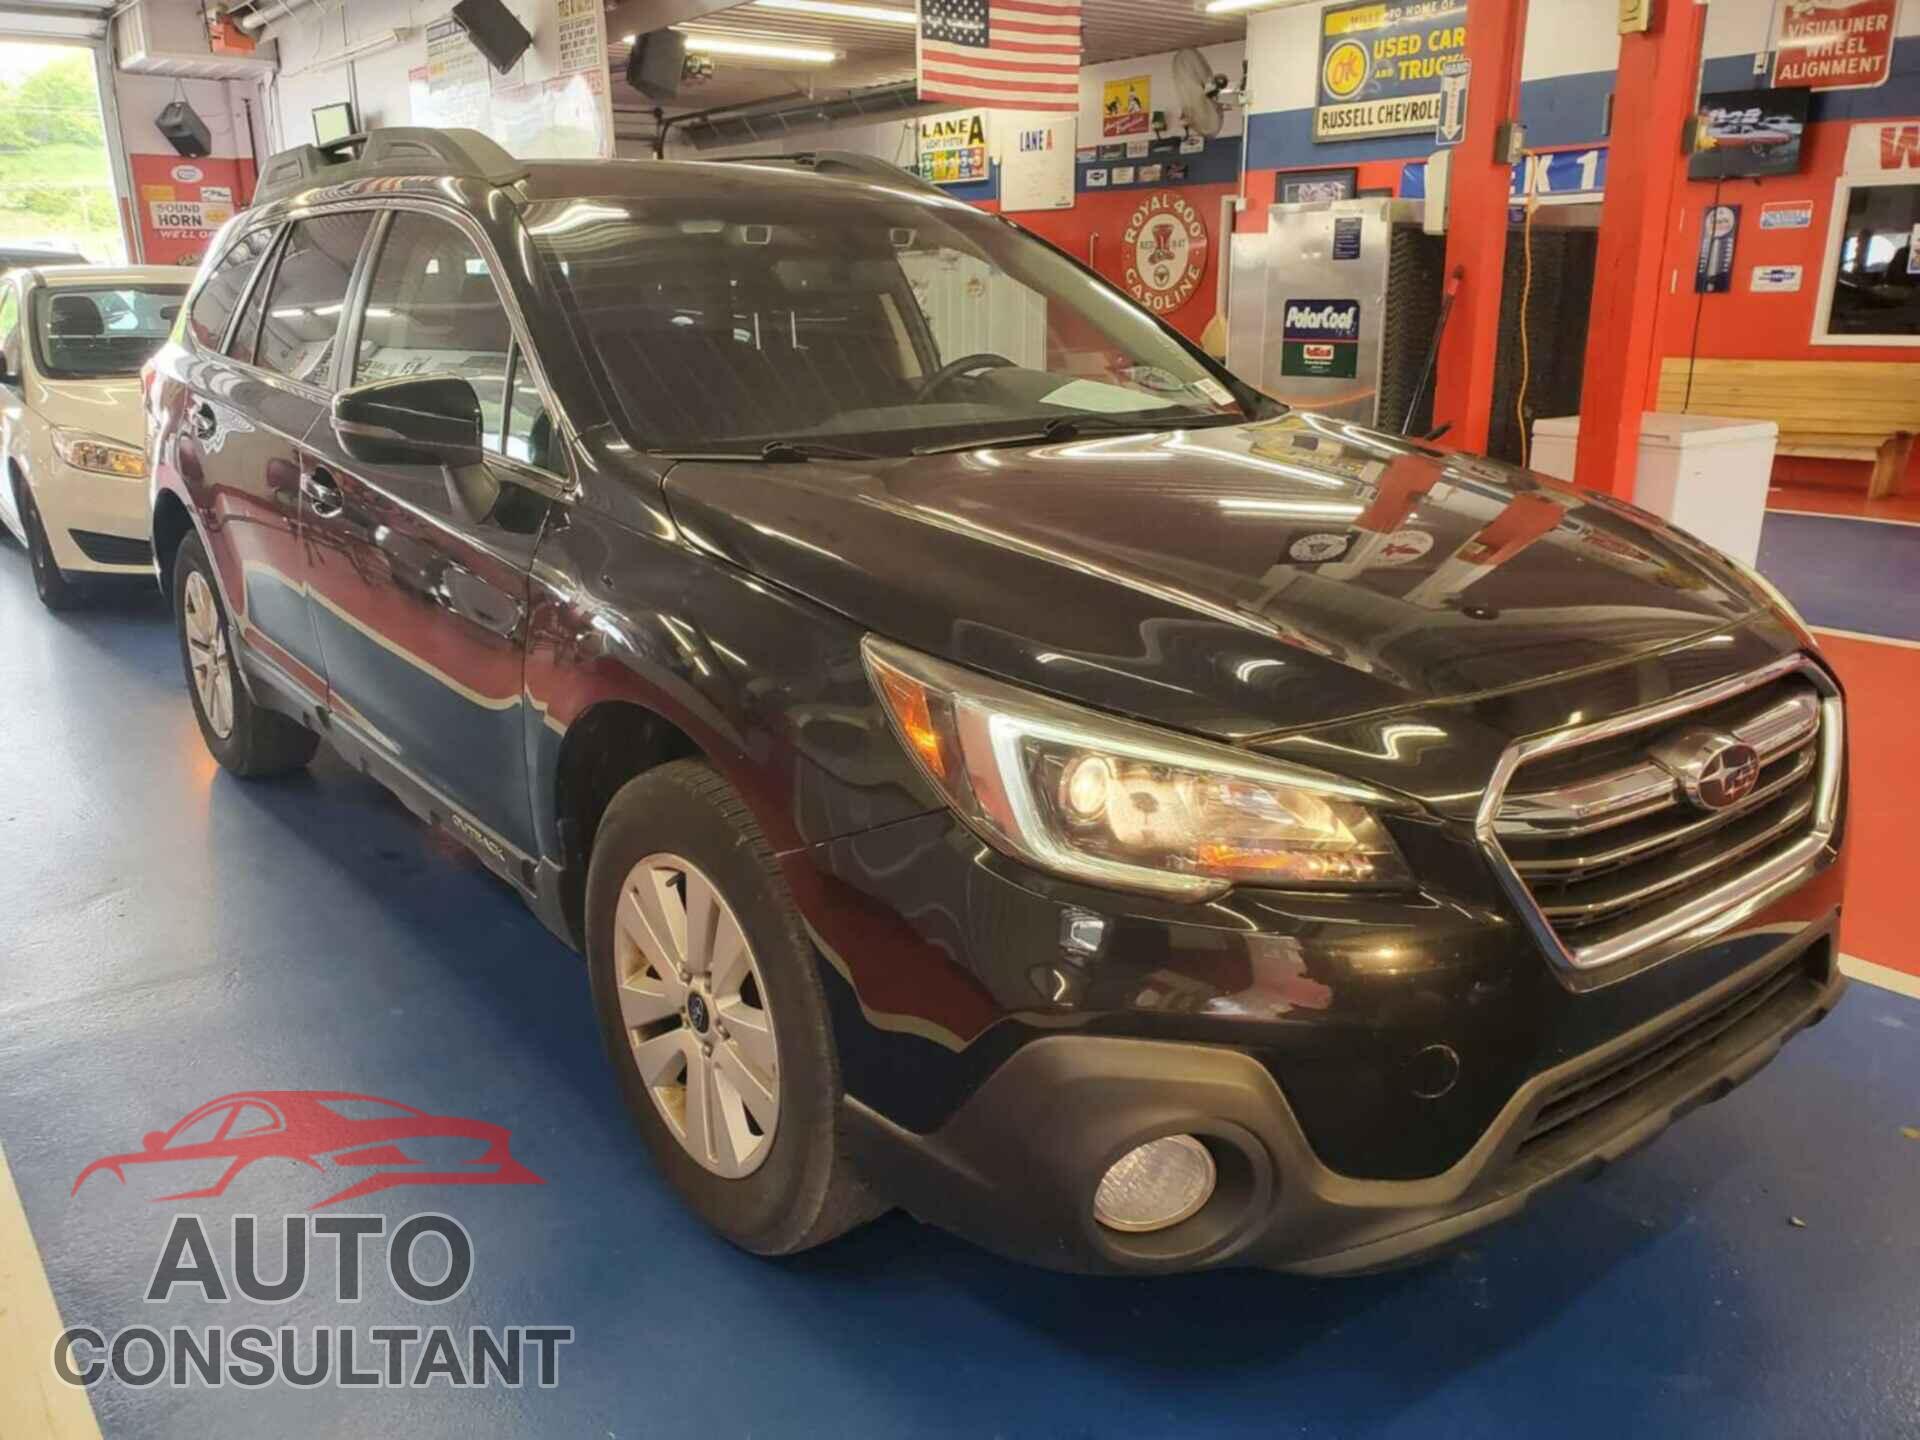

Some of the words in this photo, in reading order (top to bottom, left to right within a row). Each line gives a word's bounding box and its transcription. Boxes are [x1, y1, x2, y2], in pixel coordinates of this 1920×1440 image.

[1787, 14, 1888, 39] VISUALINER
[1373, 33, 1421, 60] USED
[1428, 26, 1466, 51] CAR
[1805, 36, 1867, 57] WHEEL
[1398, 54, 1465, 80] TRUC
[1780, 55, 1884, 80] ALIGNMENT
[1322, 106, 1373, 129] RUSSELL
[1377, 100, 1440, 124] CHEVROLE
[922, 119, 968, 138] LANE
[968, 115, 985, 145] A
[1020, 129, 1043, 152] LANE
[1046, 128, 1053, 150] A
[1577, 151, 1598, 191] 1
[157, 203, 199, 213] SOUND
[160, 215, 202, 226] HORN
[1124, 194, 1169, 244] ROYAL
[1174, 200, 1201, 237] 400
[1126, 264, 1200, 309] GASOLINE
[1285, 305, 1357, 330] PolarCool
